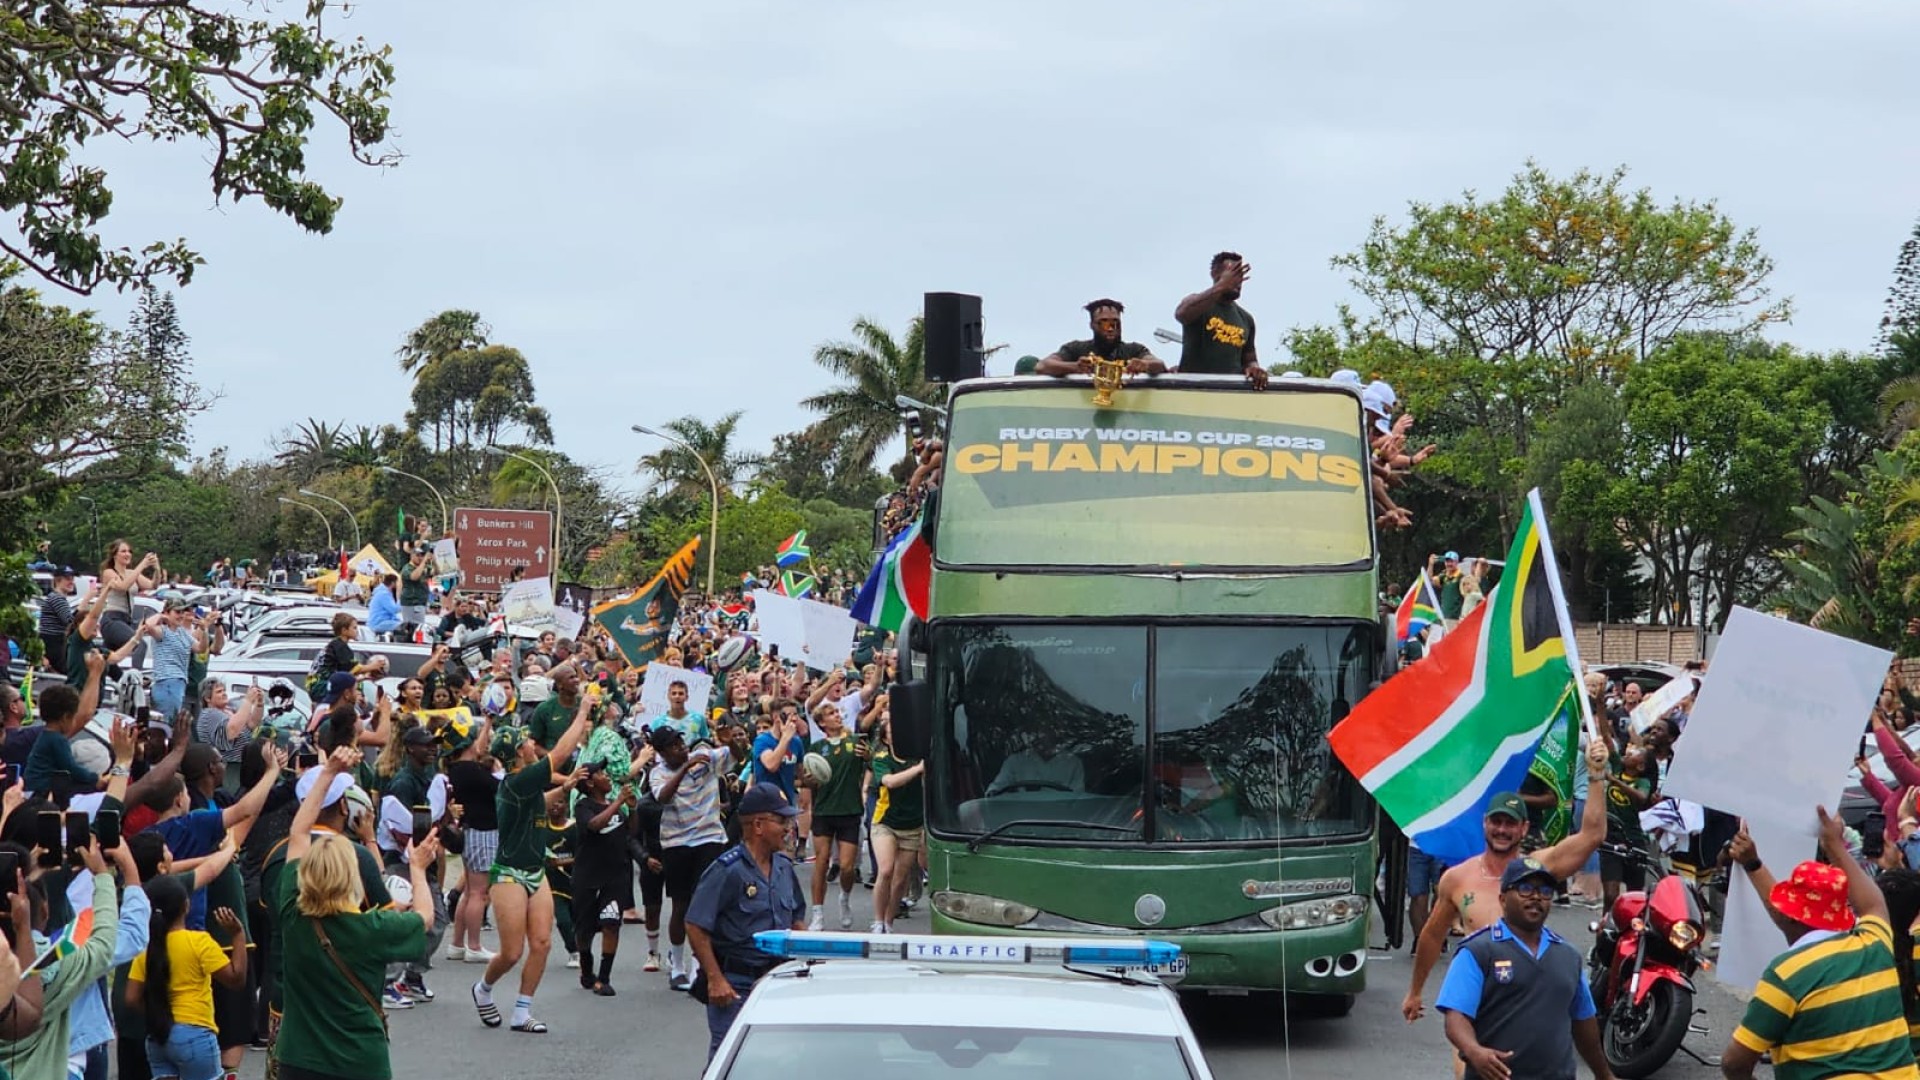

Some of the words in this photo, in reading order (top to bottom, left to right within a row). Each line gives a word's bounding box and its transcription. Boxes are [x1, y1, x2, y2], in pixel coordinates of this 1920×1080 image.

[999, 427, 1091, 441] RUGBY
[1095, 428, 1192, 443] WORLD
[1196, 431, 1252, 445] CUP
[1255, 435, 1326, 450] 2023
[954, 442, 1362, 488] CHAMPIONS
[477, 517, 516, 528] Bunkers
[519, 519, 534, 529] Hill
[477, 538, 503, 547] Xerox
[506, 538, 528, 548] Park
[475, 556, 501, 567] Philip
[475, 574, 495, 584] East
[916, 944, 1017, 957] TRAFFIC
[1169, 959, 1185, 973] GP
